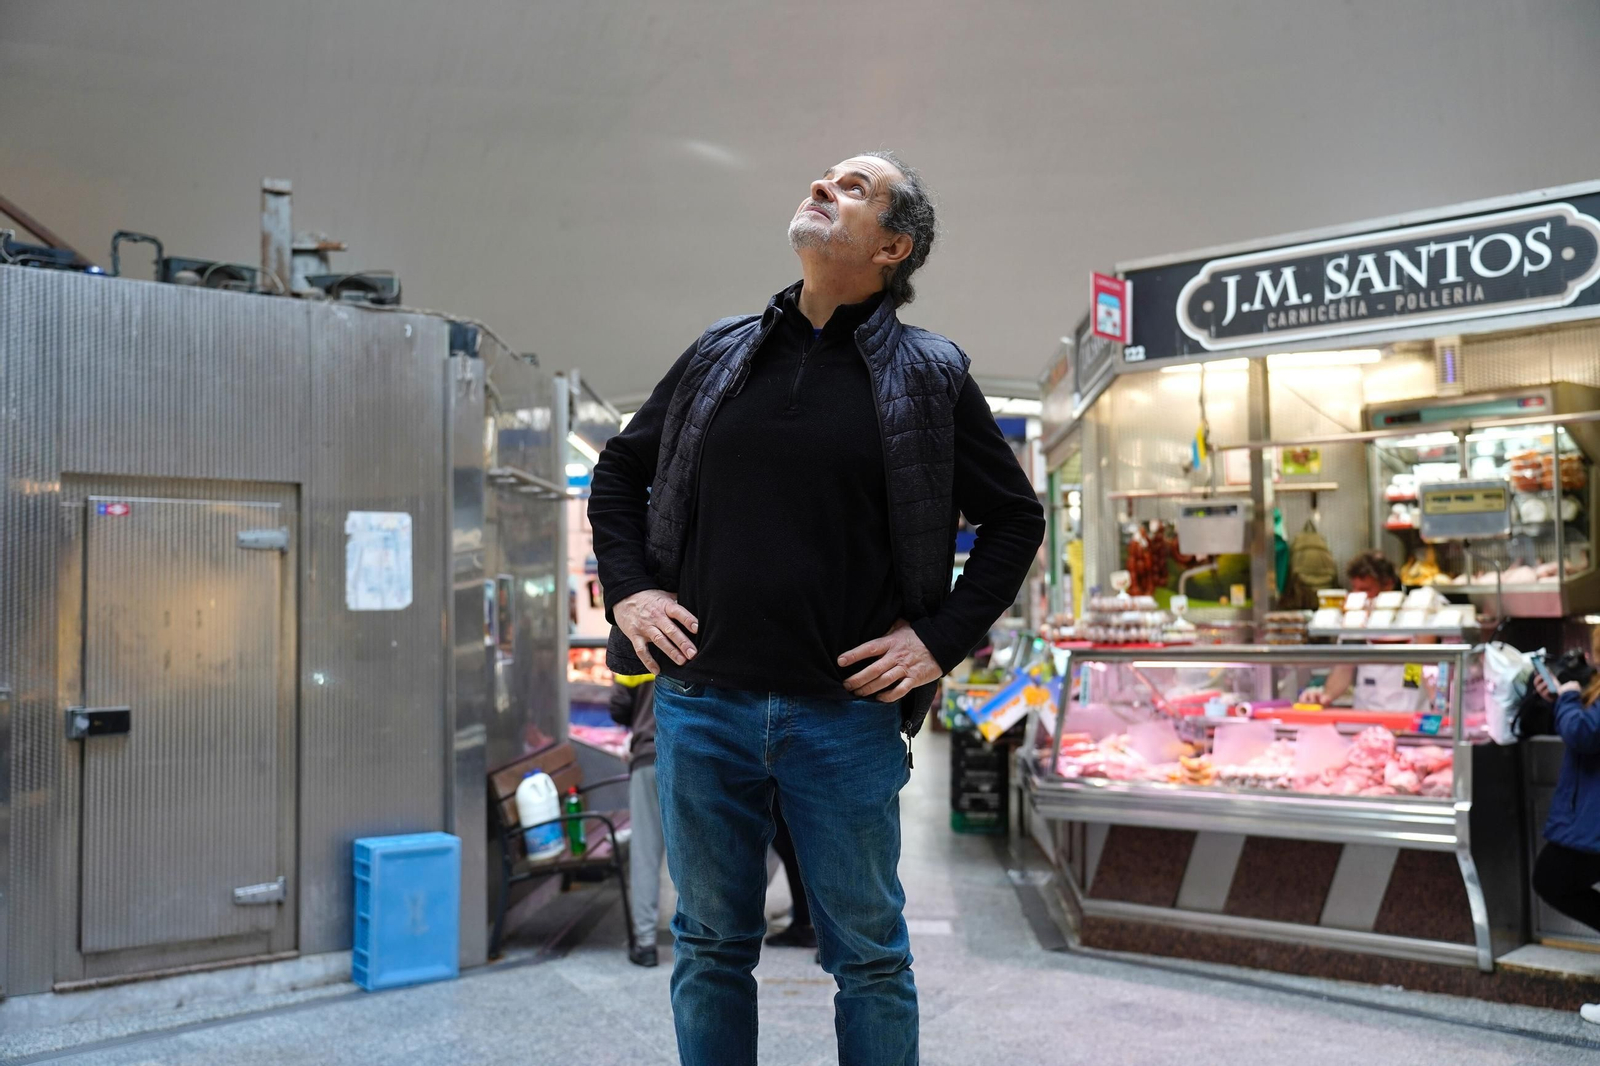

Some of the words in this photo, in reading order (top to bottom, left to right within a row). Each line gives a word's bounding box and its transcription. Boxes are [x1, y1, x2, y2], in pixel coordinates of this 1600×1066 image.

[1221, 266, 1313, 327] J.M.
[1323, 221, 1553, 305] SANTOS
[1267, 299, 1368, 329] CARNICERÍA
[1395, 282, 1485, 312] POLLERÍA
